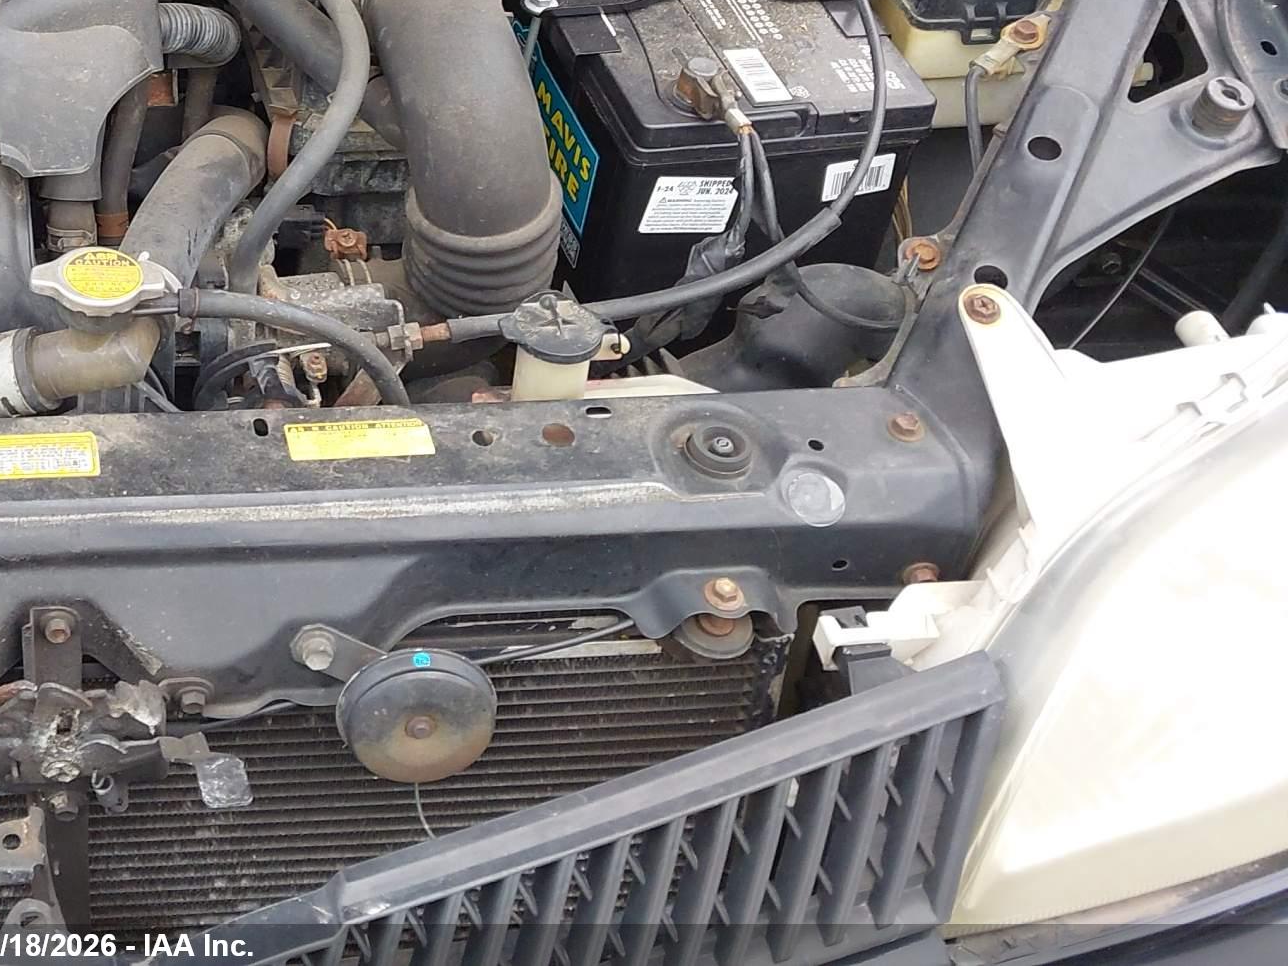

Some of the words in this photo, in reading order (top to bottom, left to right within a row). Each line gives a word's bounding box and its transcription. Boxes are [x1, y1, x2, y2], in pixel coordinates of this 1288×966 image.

[536, 80, 591, 182] MAVIS
[698, 179, 732, 188] SHIPPED
[696, 187, 713, 195] JUN.
[714, 187, 733, 195] 2024
[74, 259, 130, 267] CAUTION
[325, 423, 369, 431] CAUTION
[376, 420, 423, 429] ATTENTION
